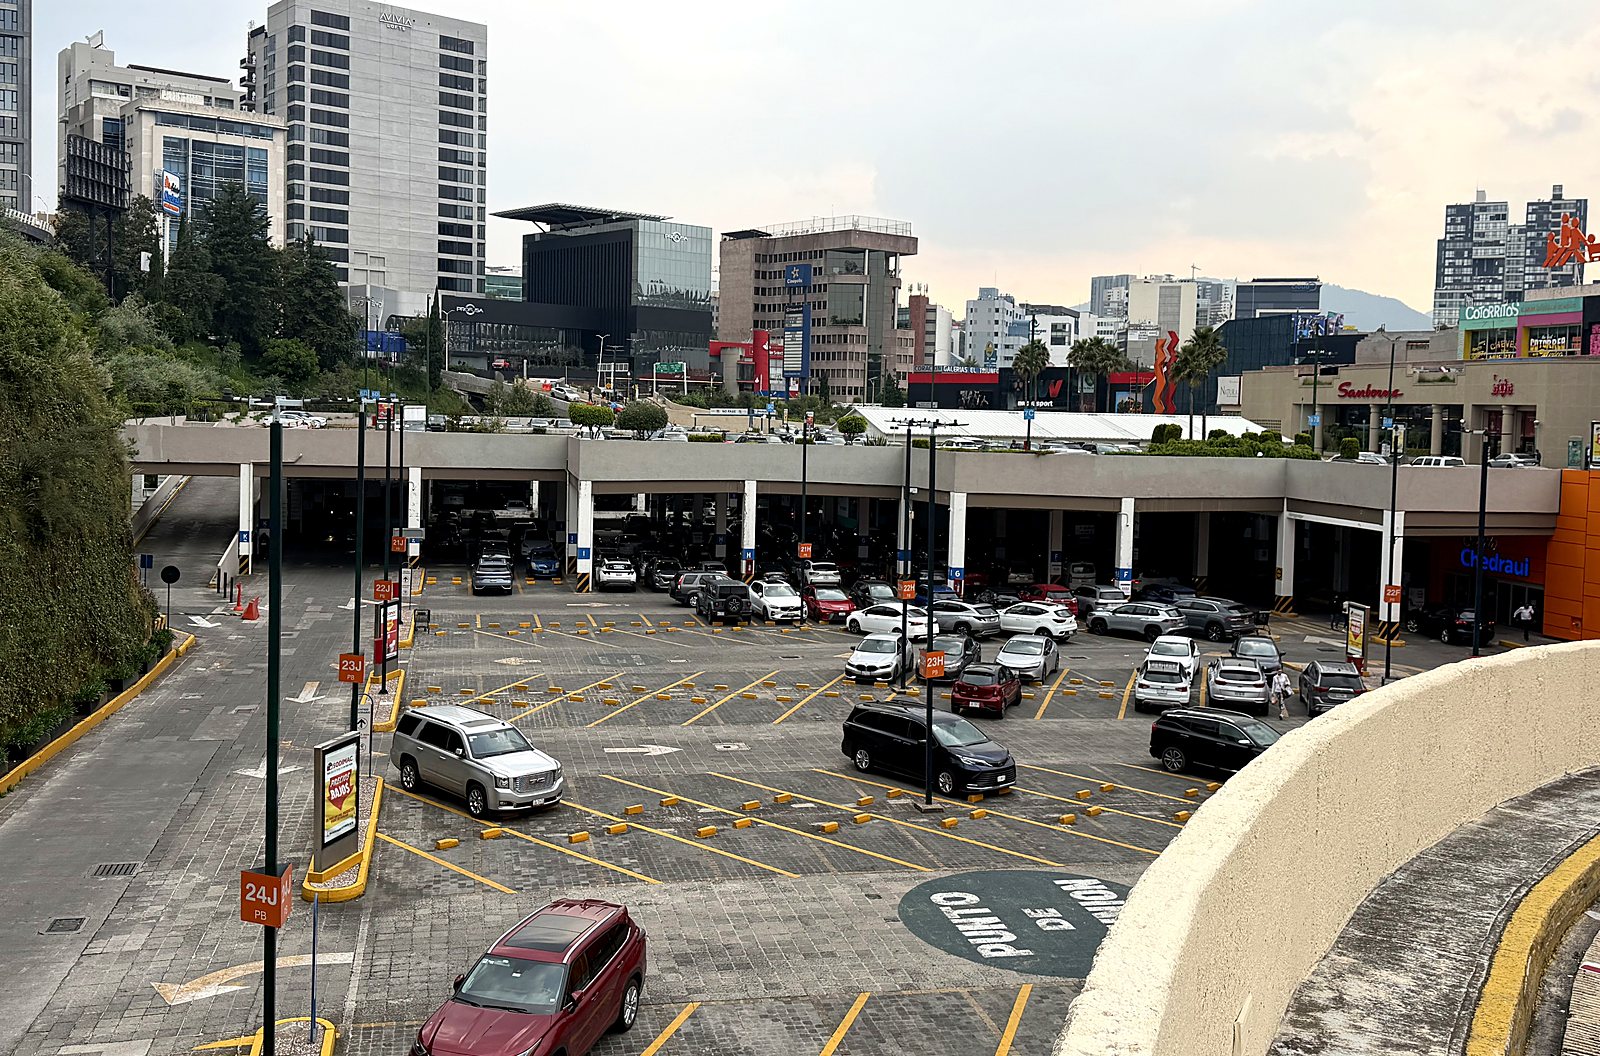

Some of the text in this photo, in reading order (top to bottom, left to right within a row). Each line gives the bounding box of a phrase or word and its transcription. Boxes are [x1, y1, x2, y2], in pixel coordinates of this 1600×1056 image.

[380, 12, 412, 26] AVIVIA
[1460, 548, 1530, 577] Chedraui
[375, 584, 391, 592] 22J
[903, 583, 915, 592] 22H
[341, 659, 362, 672] 23J
[927, 656, 943, 668] 23H
[330, 782, 351, 800] BAJOS
[245, 883, 278, 906] 24J
[254, 909, 267, 920] PB
[1021, 907, 1077, 931] DE
[930, 891, 1034, 959] PUNTO
